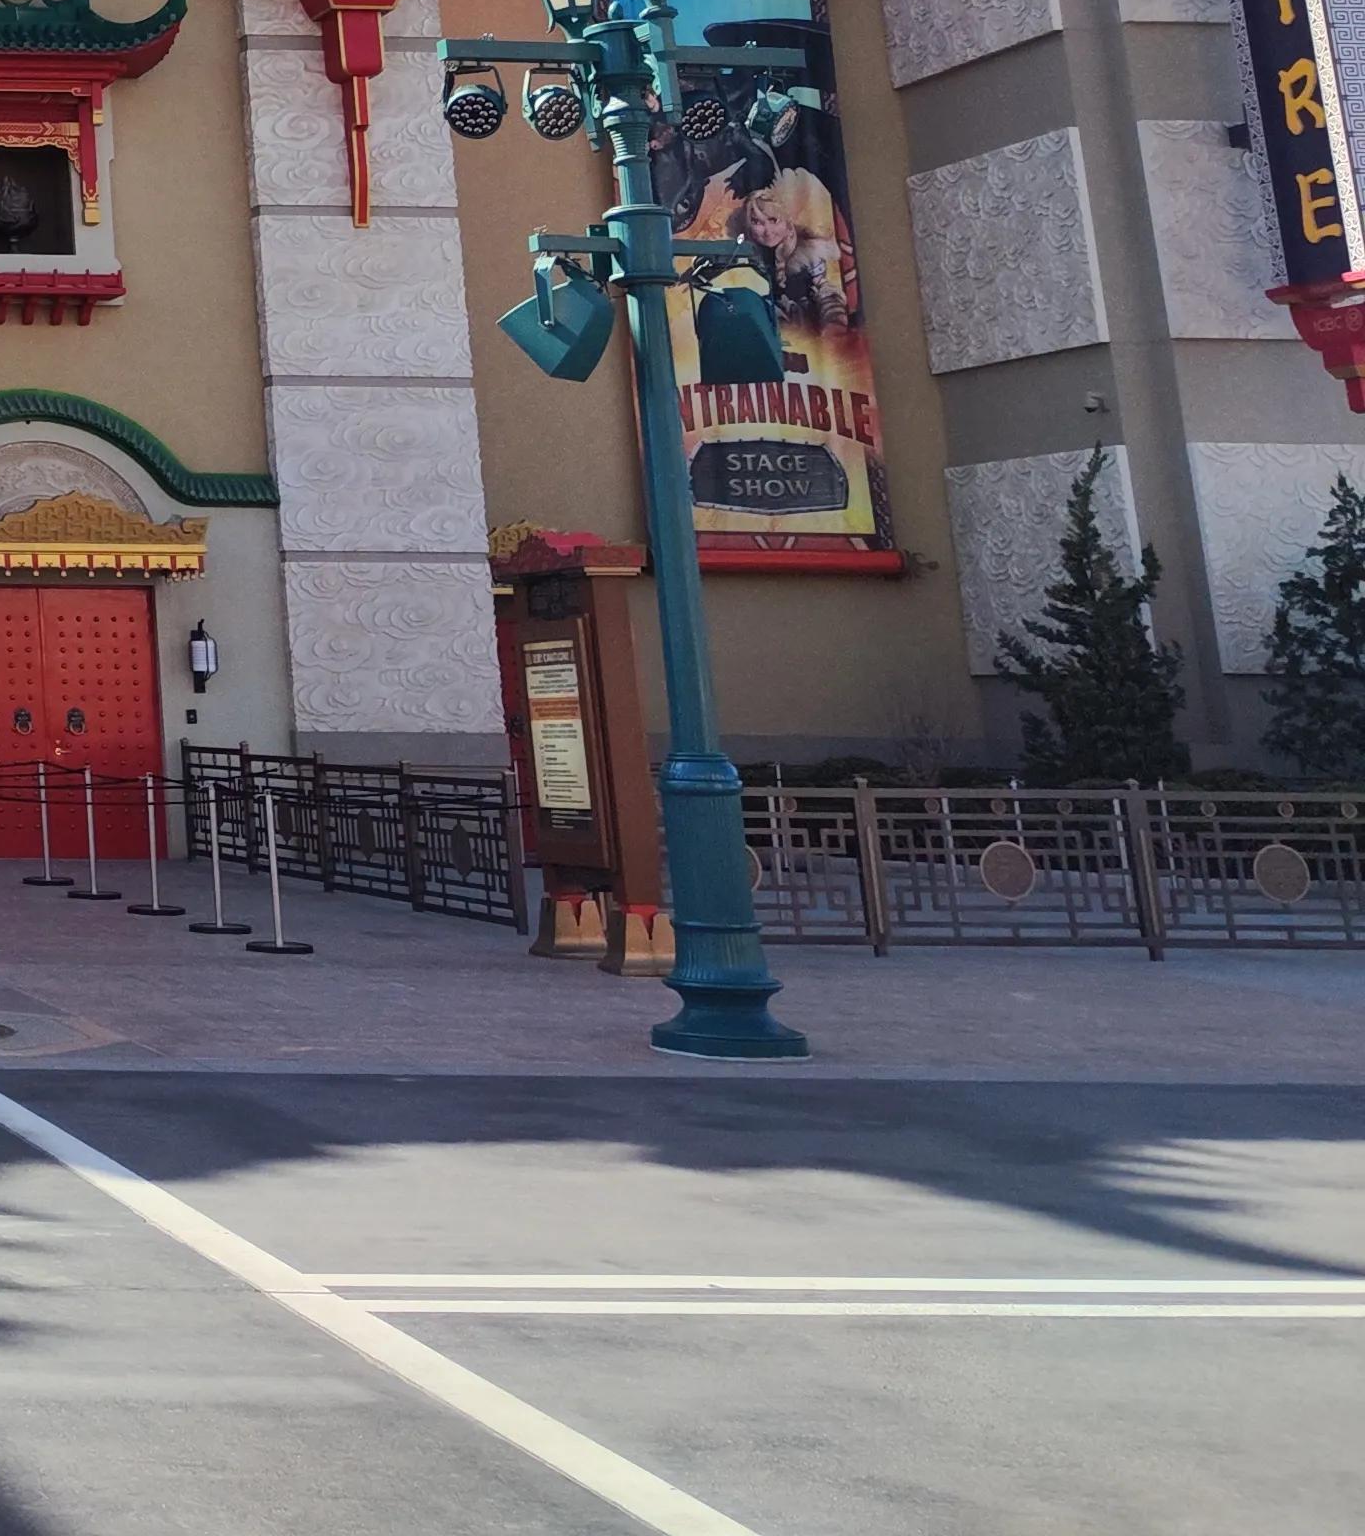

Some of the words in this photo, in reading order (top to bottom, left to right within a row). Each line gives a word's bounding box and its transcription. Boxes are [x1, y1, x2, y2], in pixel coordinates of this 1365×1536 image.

[677, 382, 875, 448] NTRAINABLE
[725, 453, 809, 473] STAGE
[728, 478, 813, 498] SHOW
